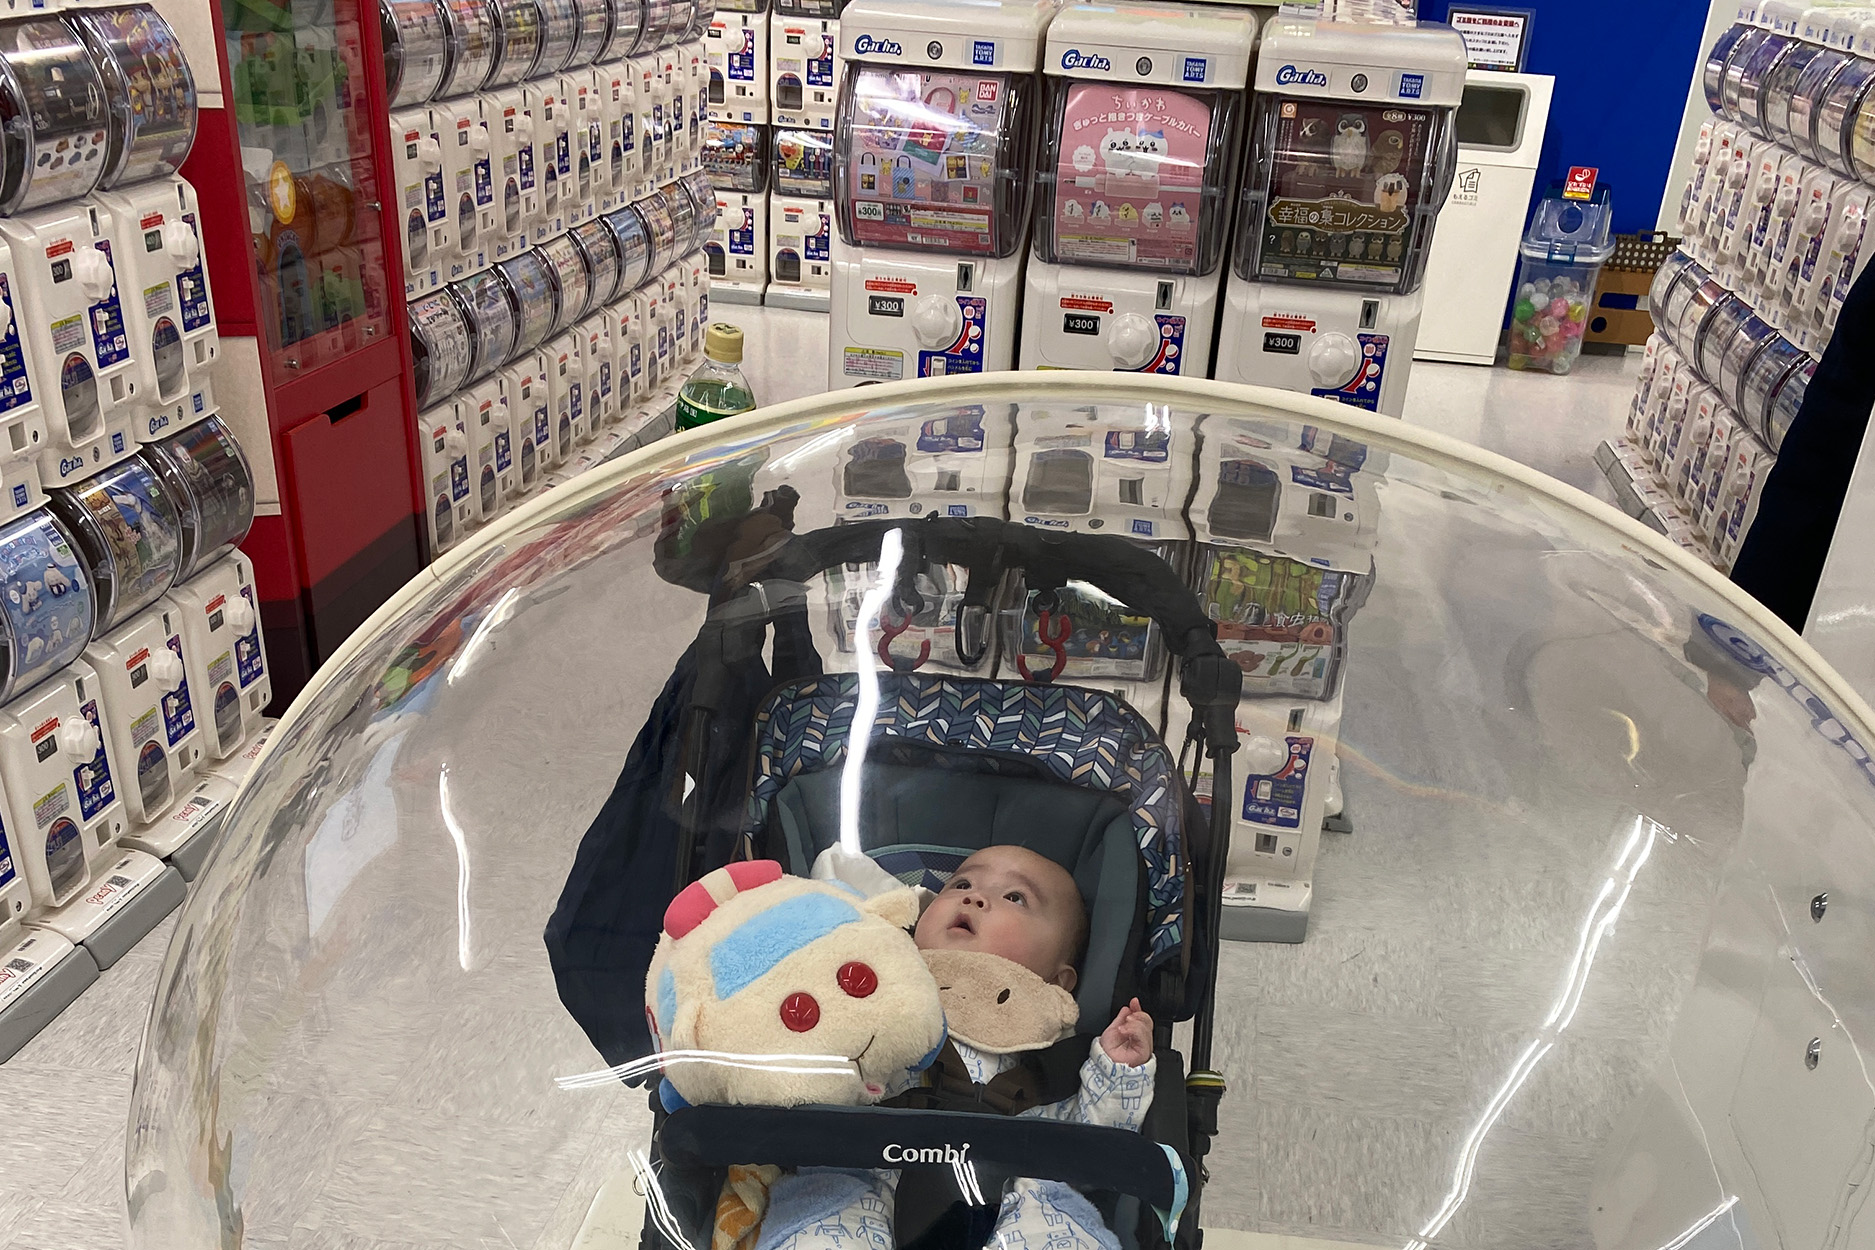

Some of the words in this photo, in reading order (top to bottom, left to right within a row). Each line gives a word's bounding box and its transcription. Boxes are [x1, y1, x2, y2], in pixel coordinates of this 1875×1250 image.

[1186, 66, 1204, 74] TOMY
[1111, 95, 1167, 111] ちいかわ
[1073, 112, 1201, 138] ぎゅっと抱きつきケーブルカバー
[1278, 206, 1401, 230] 幸福の梟コレクション
[874, 300, 899, 312] ¥300
[1069, 319, 1094, 330] ¥300
[1269, 336, 1294, 348] ¥300
[882, 1142, 970, 1164] Combi
